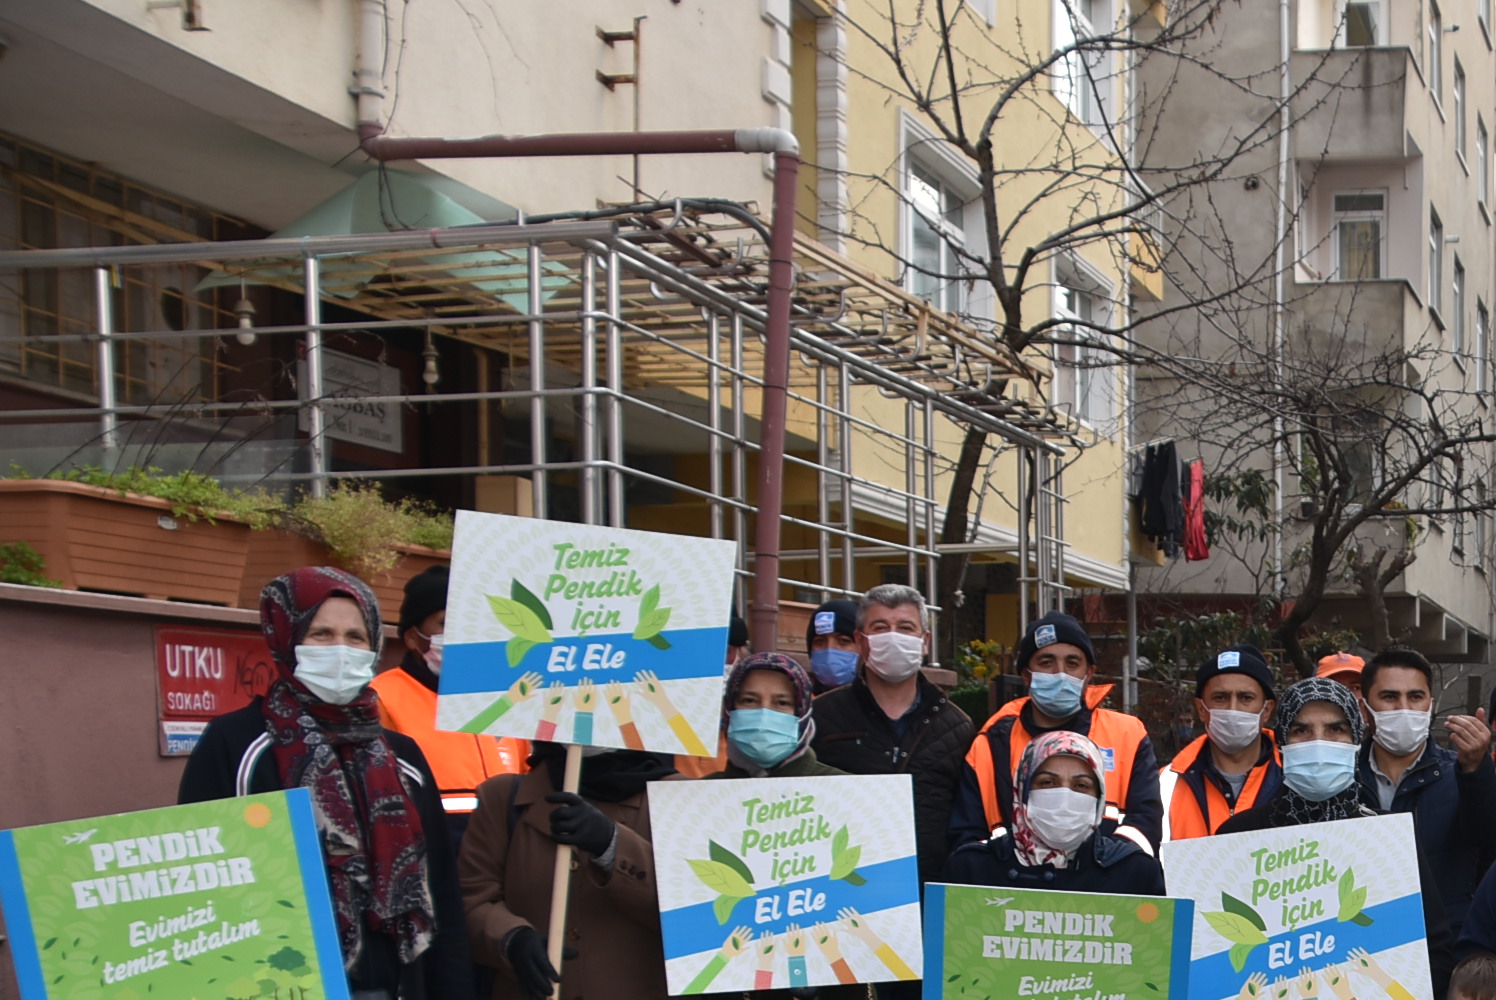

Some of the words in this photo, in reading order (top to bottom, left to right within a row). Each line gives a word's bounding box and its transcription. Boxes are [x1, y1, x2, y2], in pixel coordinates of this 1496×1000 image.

[553, 542, 630, 571] Temiz
[543, 570, 642, 601] Pendik
[165, 643, 222, 680] UTKU
[547, 645, 577, 672] El
[582, 643, 627, 671] Ele
[167, 690, 216, 711] SOKAĞI
[742, 791, 815, 826] Temiz
[741, 814, 831, 857] Pendik
[1250, 838, 1320, 876] Temiz
[1252, 859, 1338, 906] Pendik
[129, 900, 216, 947] Evimizi
[755, 895, 782, 924] El
[787, 888, 826, 917] Ele
[103, 948, 170, 984] temiz
[172, 919, 260, 961] tutalım
[1268, 940, 1294, 970] El
[1299, 931, 1336, 960] Ele
[1018, 971, 1094, 996] Evimizi
